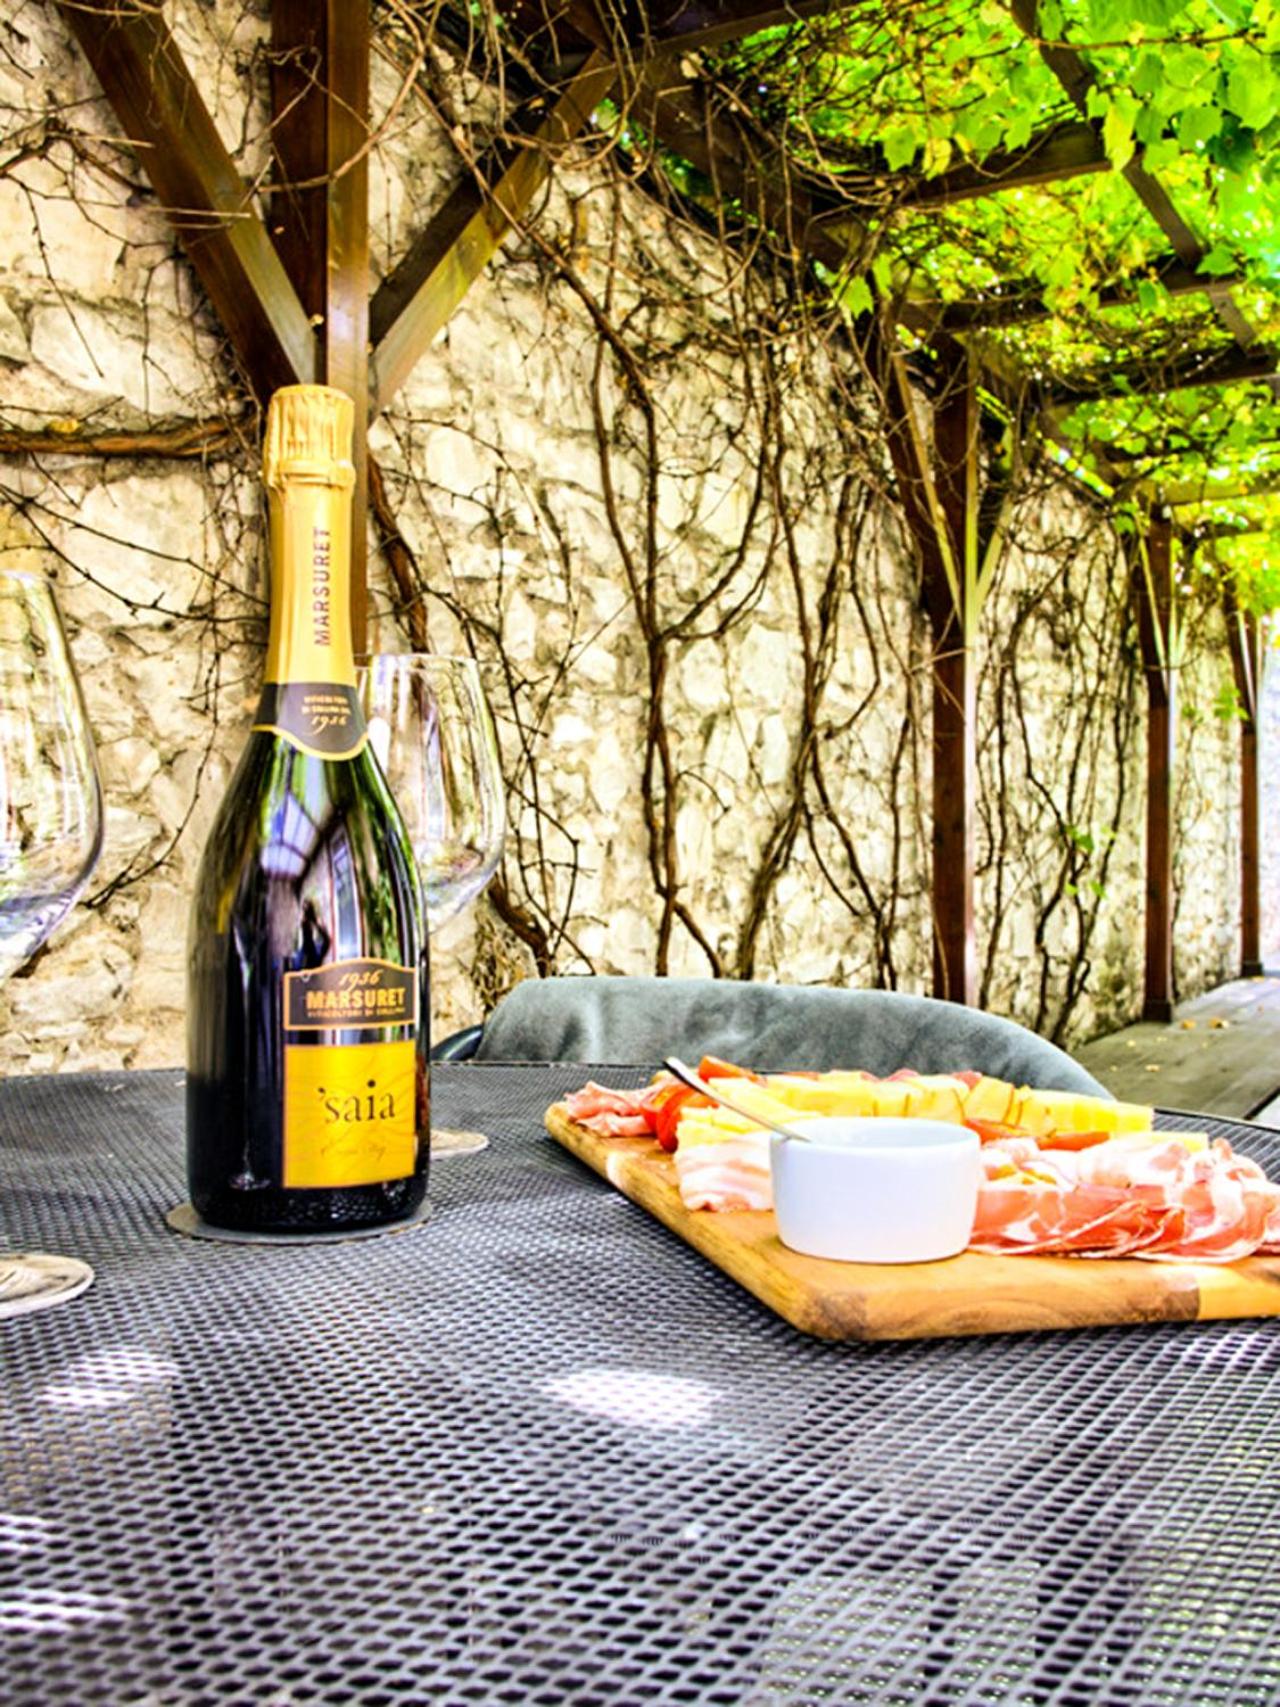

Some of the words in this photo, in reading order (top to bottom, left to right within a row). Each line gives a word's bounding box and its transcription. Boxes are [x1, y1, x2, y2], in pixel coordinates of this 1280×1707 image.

[313, 526, 331, 646] MARSURET
[339, 968, 385, 993] 1936
[306, 987, 406, 1009] MARSURET
